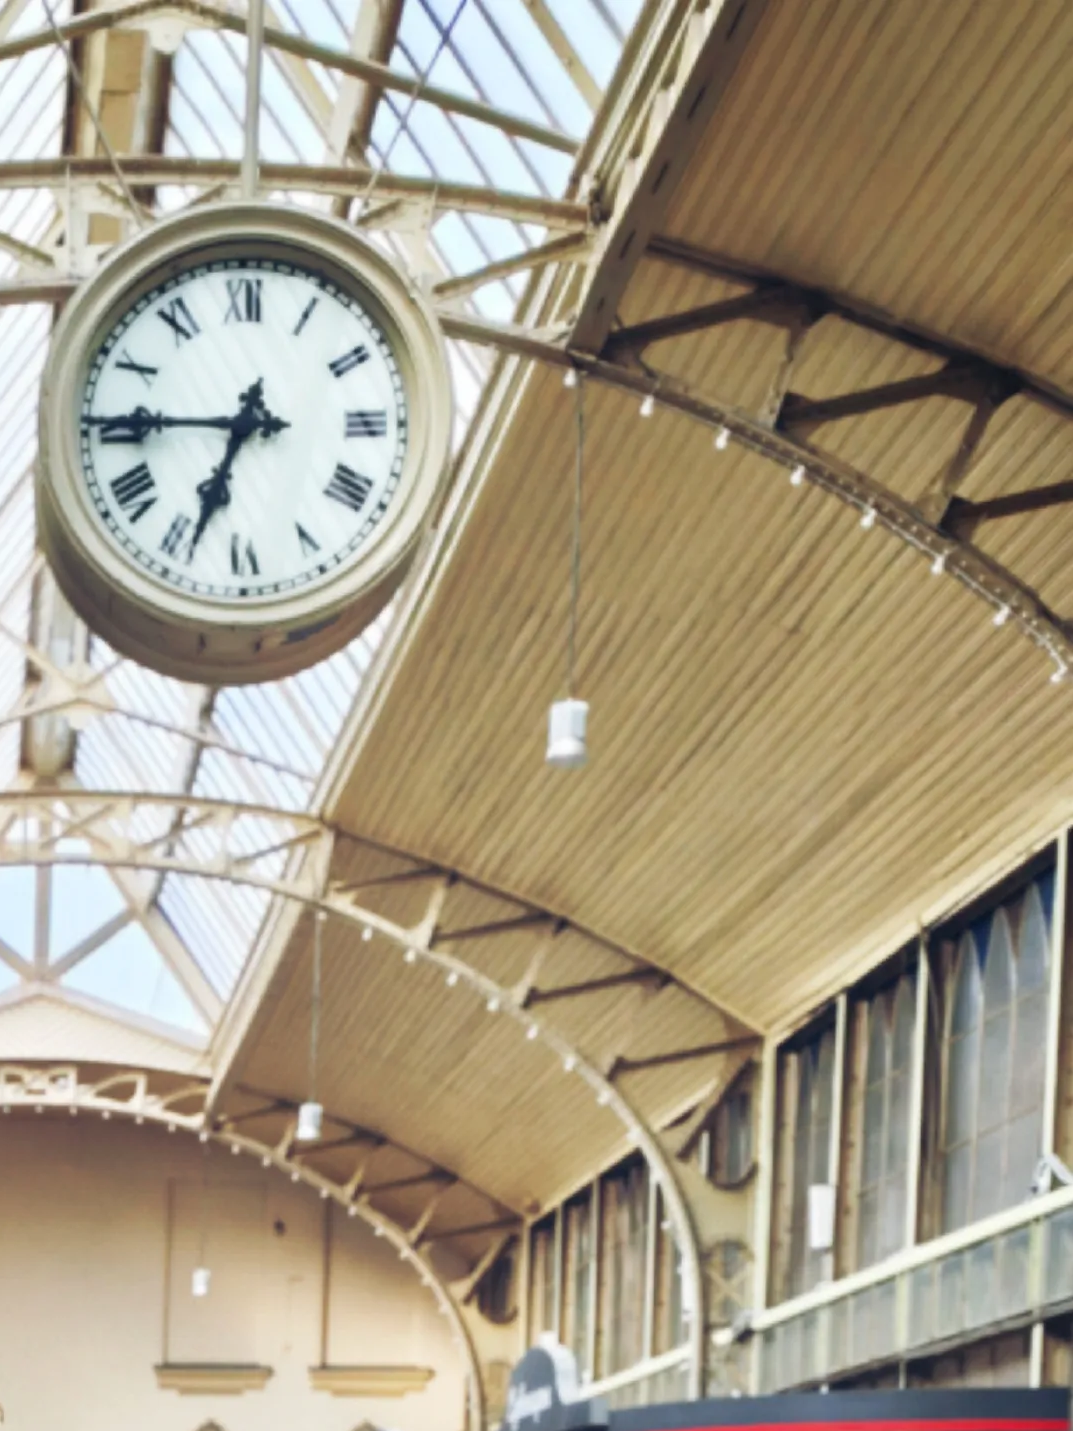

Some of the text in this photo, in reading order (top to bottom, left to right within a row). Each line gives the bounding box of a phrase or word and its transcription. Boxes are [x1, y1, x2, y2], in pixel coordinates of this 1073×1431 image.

[225, 279, 262, 324] XII
[292, 296, 319, 336] I
[157, 297, 201, 348] XI
[114, 349, 159, 389] X
[328, 344, 371, 378] II
[344, 409, 387, 438] III
[109, 461, 158, 524] VIII
[230, 532, 261, 576] VI
[294, 521, 321, 558] V
